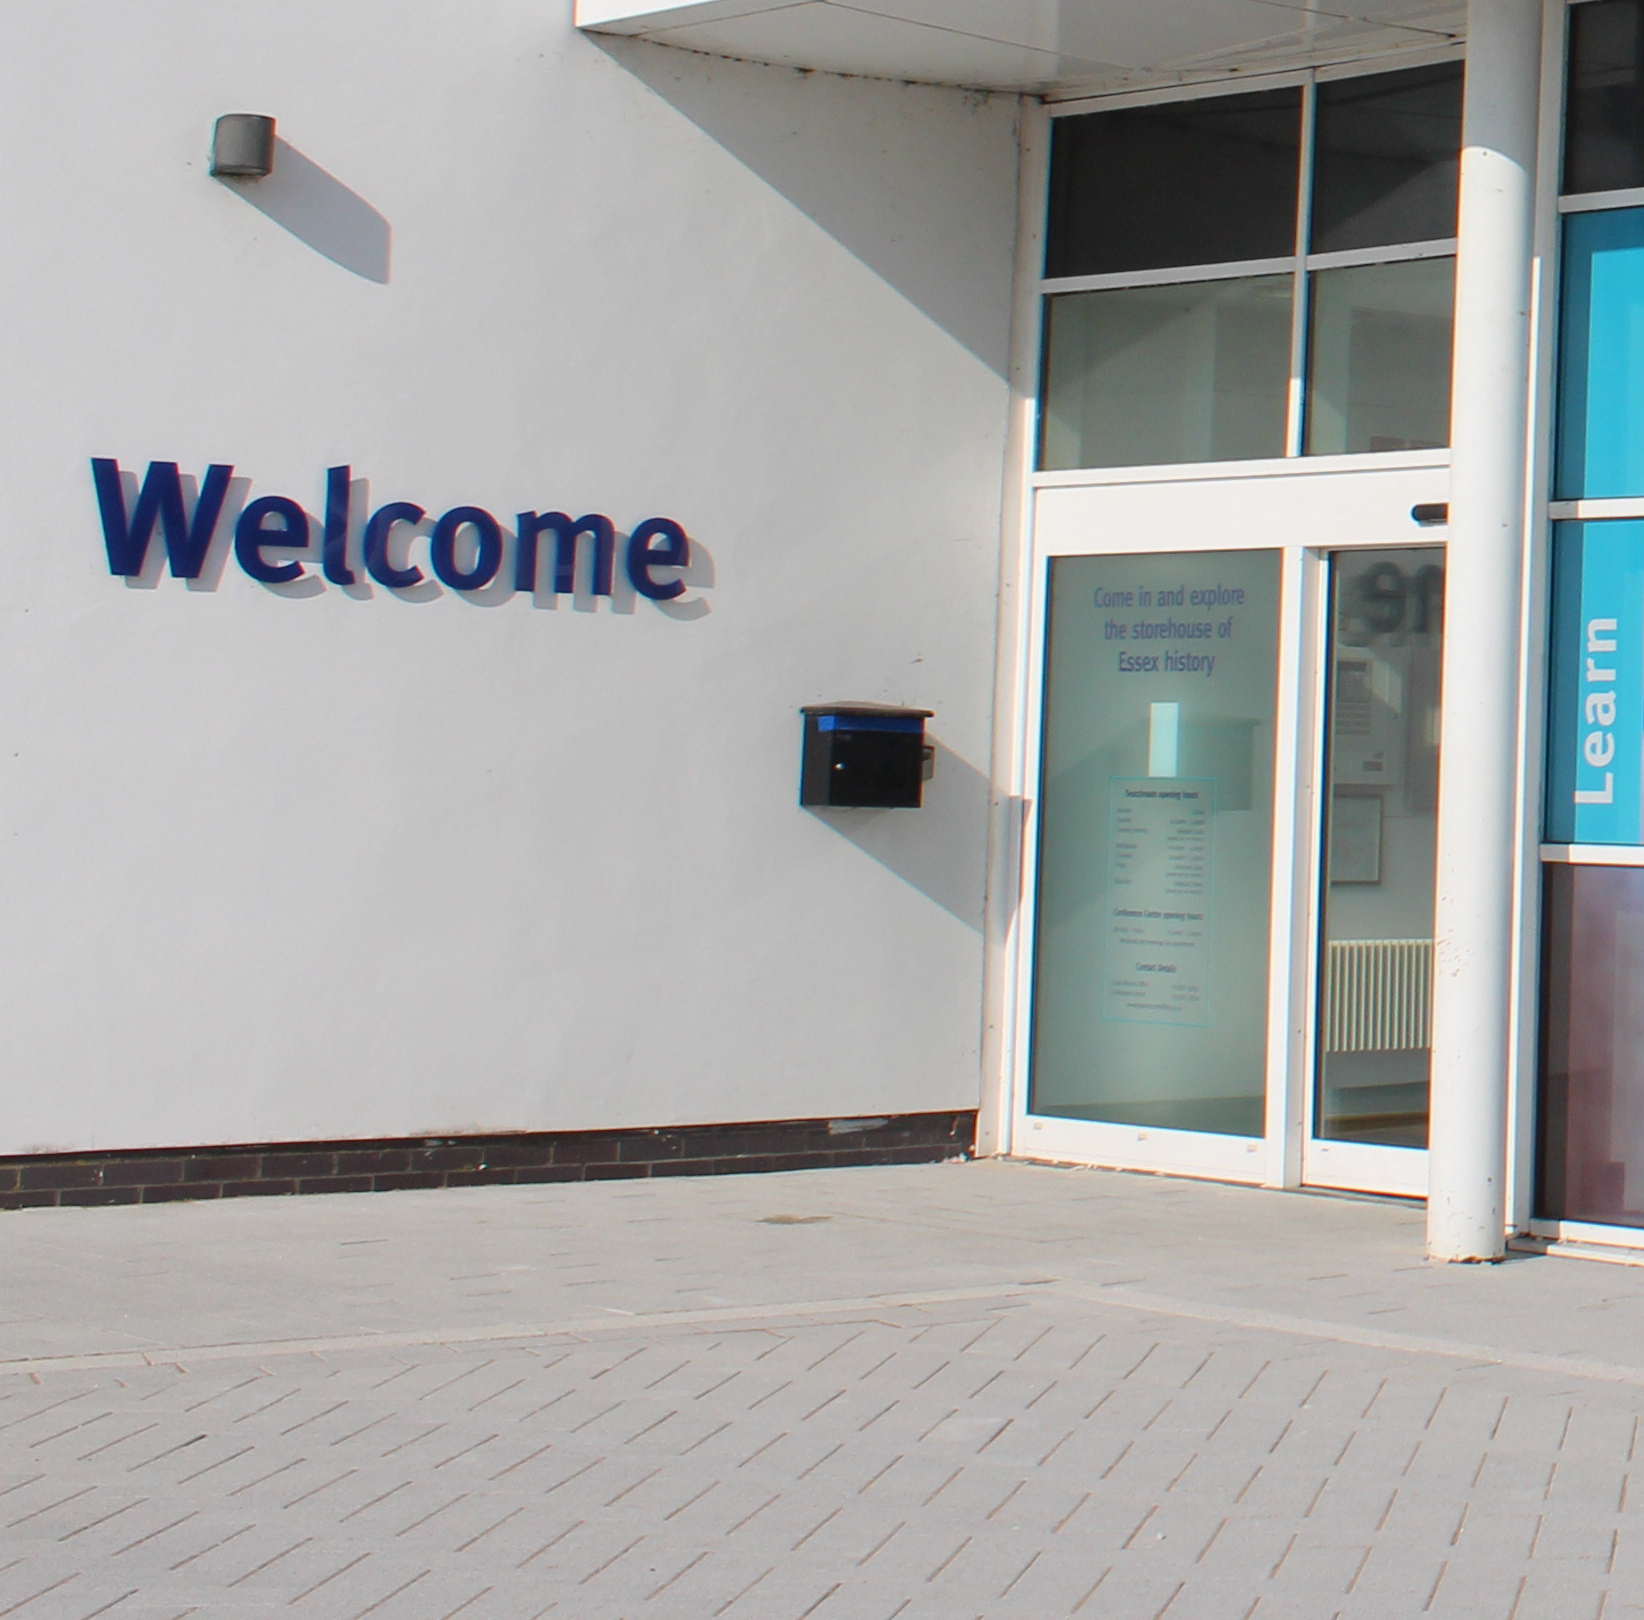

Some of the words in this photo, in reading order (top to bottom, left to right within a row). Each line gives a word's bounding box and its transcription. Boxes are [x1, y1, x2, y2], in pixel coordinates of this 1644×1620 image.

[90, 457, 692, 601] Welcome
[1094, 586, 1133, 608] Come
[1139, 586, 1151, 607] in
[1157, 584, 1184, 607] and
[1190, 583, 1245, 611] explore
[1104, 618, 1126, 640] the
[1132, 617, 1212, 640] storehouse
[1218, 615, 1234, 638] of
[1118, 651, 1158, 672] Essex
[1165, 650, 1216, 677] history
[1572, 615, 1619, 806] Learn
